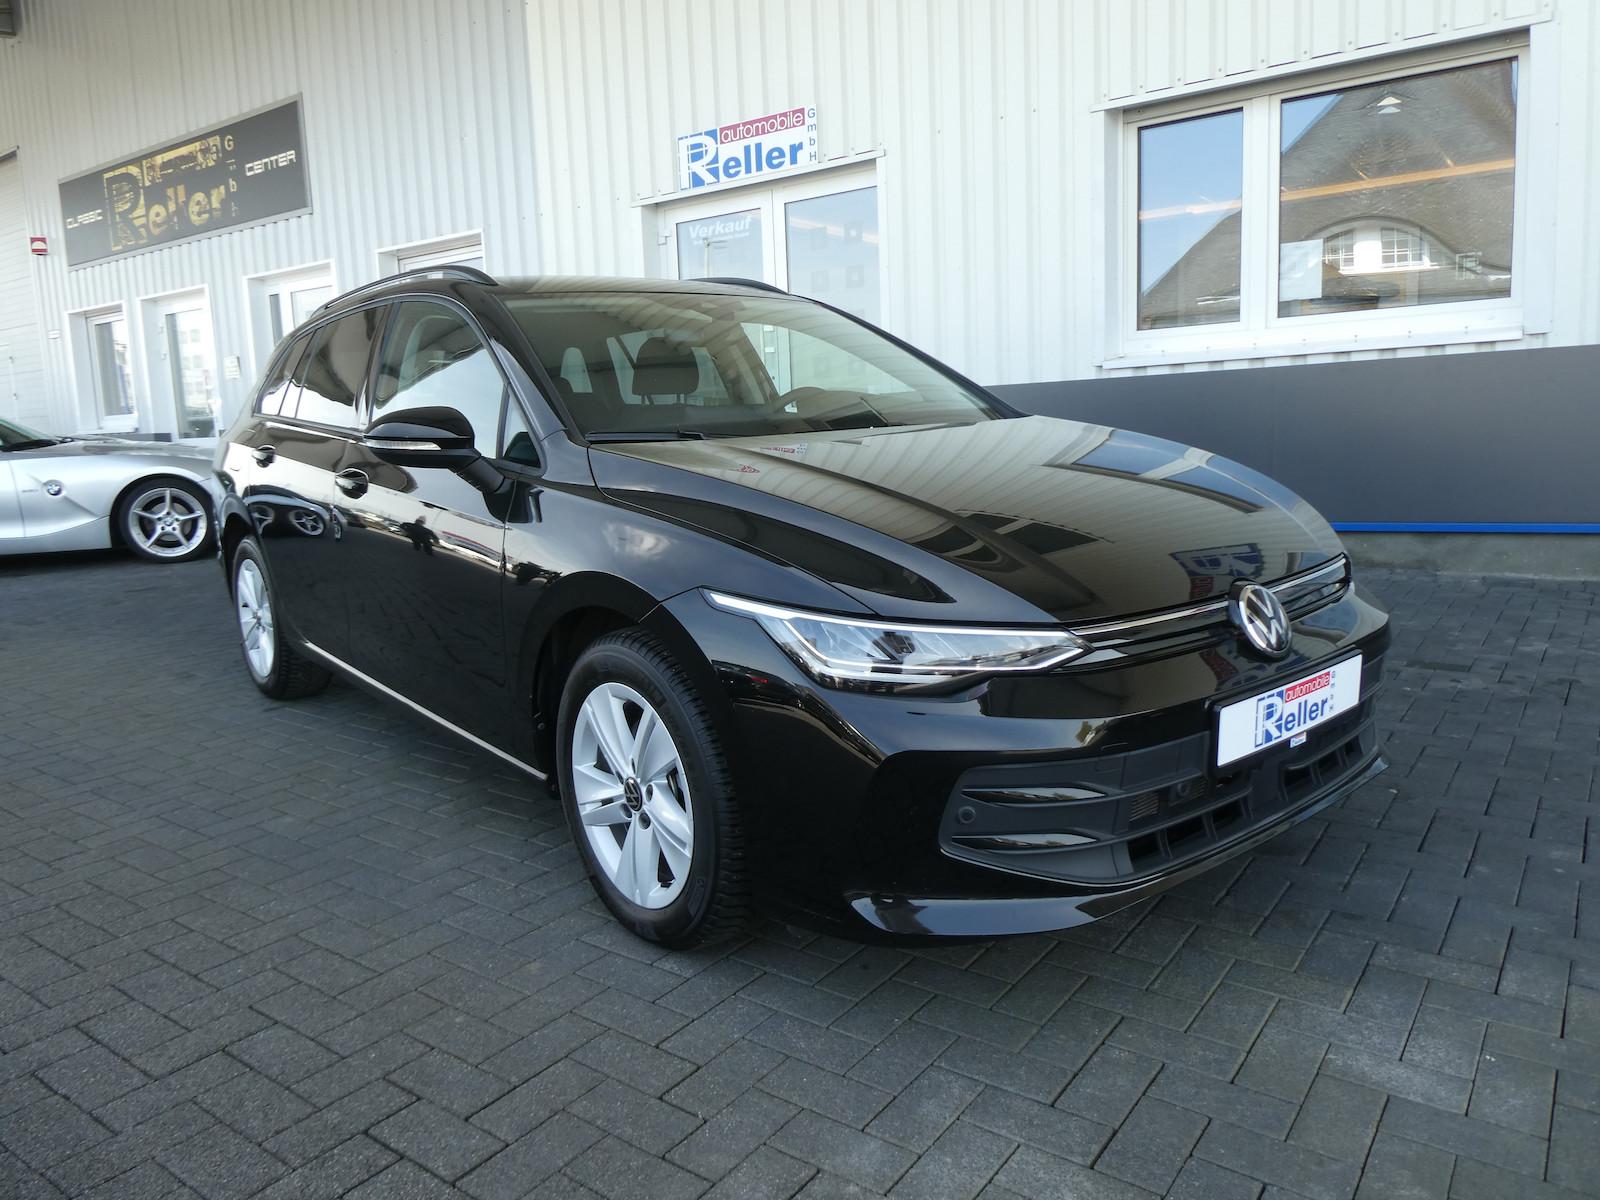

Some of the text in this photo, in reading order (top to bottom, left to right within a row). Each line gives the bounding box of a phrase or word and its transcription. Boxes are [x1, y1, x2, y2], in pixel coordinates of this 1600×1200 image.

[721, 112, 803, 143] automobile
[807, 108, 817, 161] GmbH
[245, 150, 297, 176] CENTER
[678, 128, 803, 190] Reller
[689, 216, 751, 239] Verkauf
[1285, 674, 1330, 701] automobile
[1255, 689, 1328, 748] Reller
